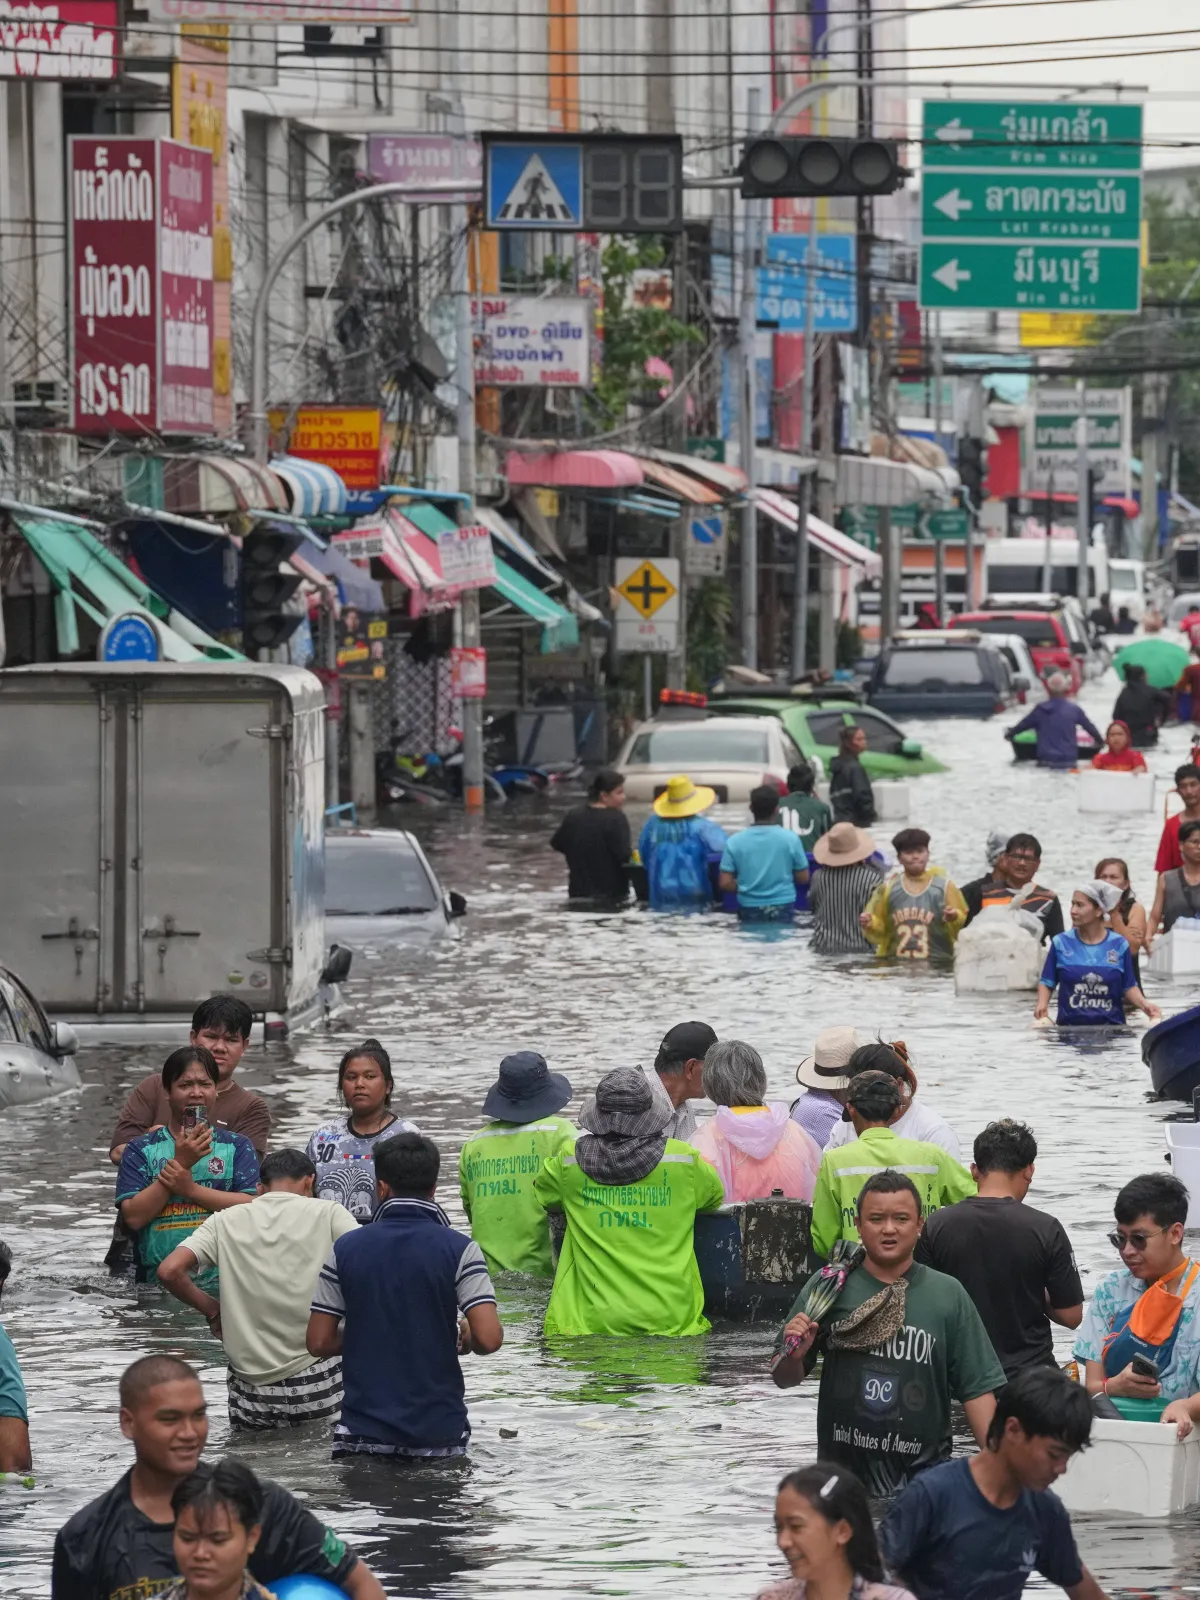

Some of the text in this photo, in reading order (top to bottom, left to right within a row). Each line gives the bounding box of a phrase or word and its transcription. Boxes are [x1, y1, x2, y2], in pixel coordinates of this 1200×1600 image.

[1001, 107, 1108, 143] ร่มเกล้า
[1010, 150, 1098, 164] Rom Klao
[74, 147, 153, 221] เหล็กดัด
[985, 179, 1126, 213] ลาดกระบัง
[1002, 221, 1111, 237] Lat Krabang
[1013, 247, 1099, 292] มีนบุรี
[1017, 292, 1096, 305] Min Buri
[497, 326, 529, 338] DVD
[80, 363, 150, 416] กระจก
[893, 907, 934, 926] JORDAN
[896, 924, 929, 958] 23
[1069, 994, 1112, 1012] Chang
[316, 1143, 335, 1163] 30
[477, 1179, 521, 1197] กทม.
[599, 1211, 653, 1228] กทม.
[865, 1379, 892, 1402] DC
[853, 1428, 878, 1450] States
[881, 1432, 891, 1452] of
[892, 1434, 922, 1454] America
